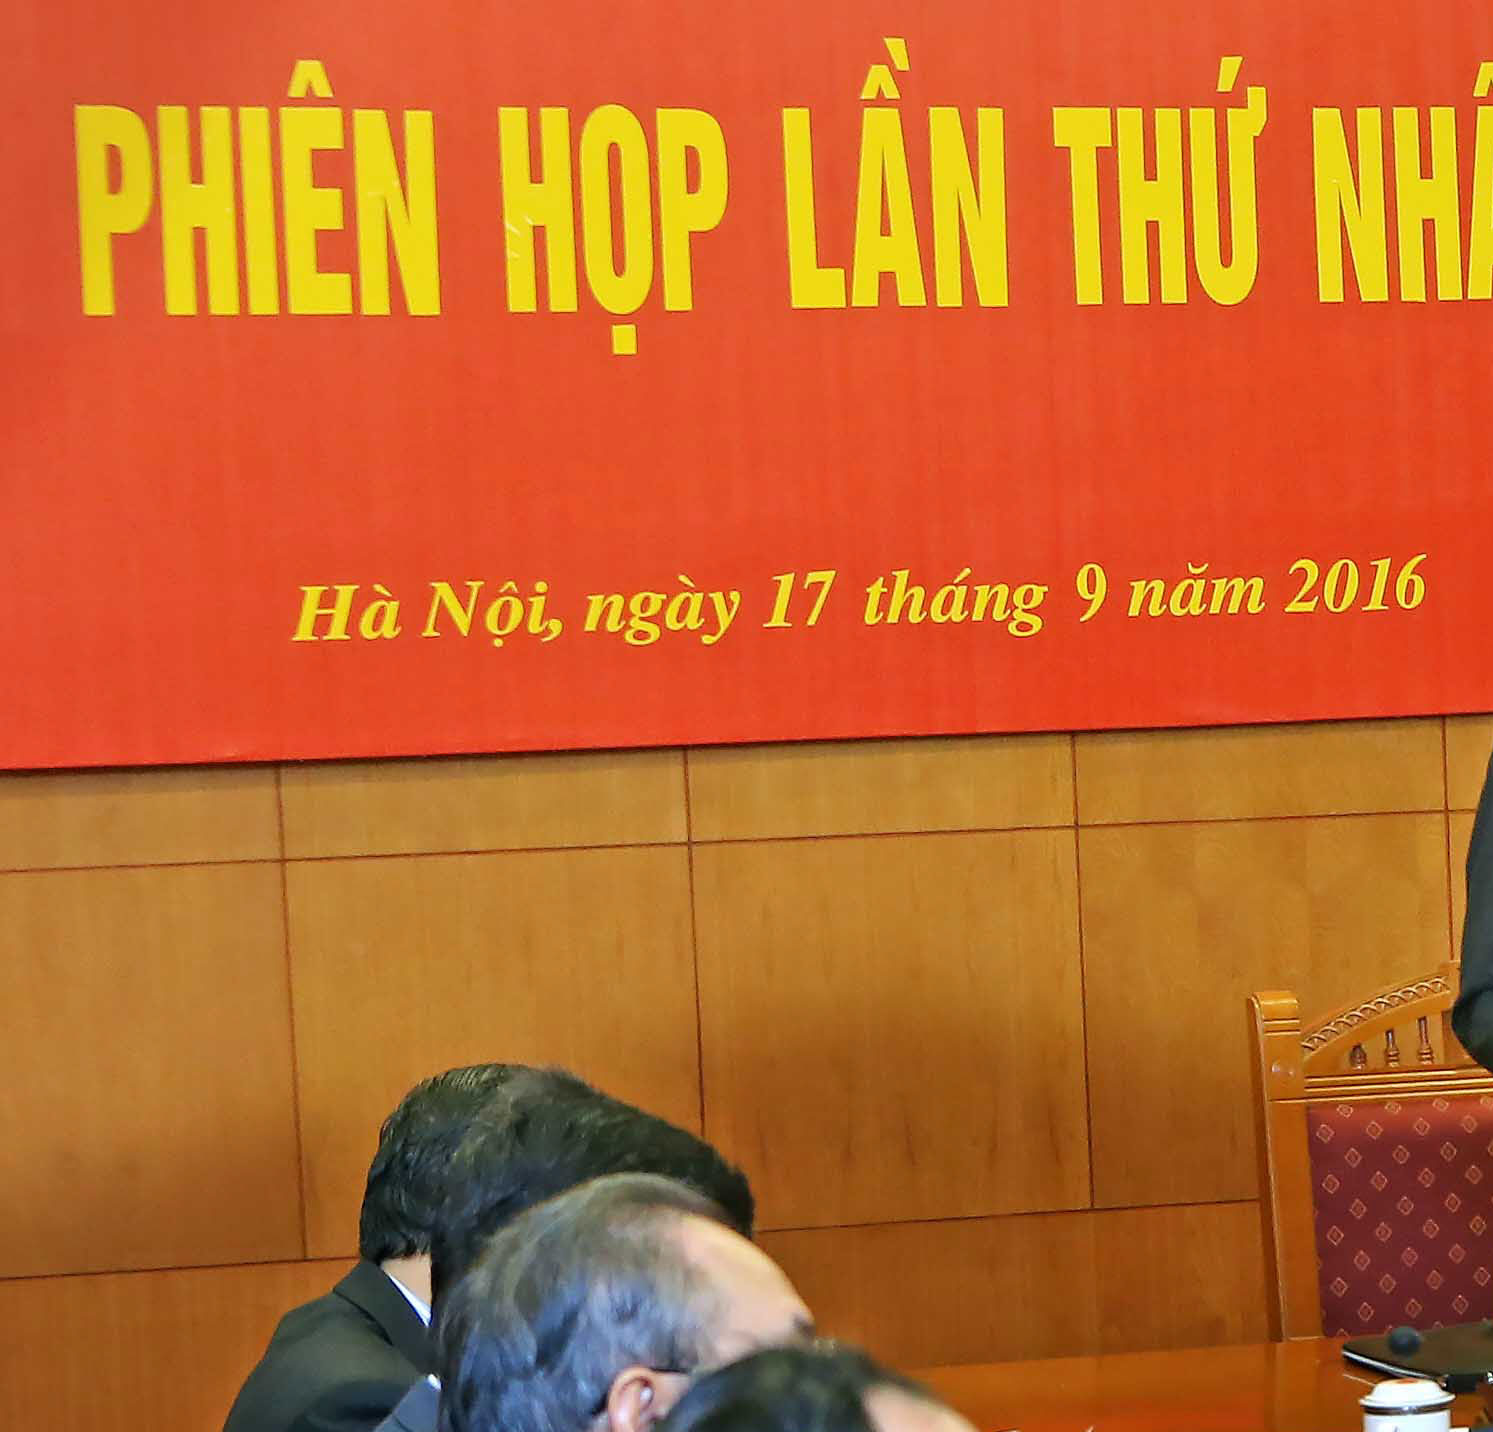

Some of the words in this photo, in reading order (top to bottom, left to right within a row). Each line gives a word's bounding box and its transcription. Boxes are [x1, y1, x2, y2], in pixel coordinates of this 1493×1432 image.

[75, 60, 441, 317] PHIÊN
[498, 103, 729, 355] HỌP
[781, 37, 1009, 309] LẦN
[1053, 55, 1268, 306] THỨ
[292, 583, 402, 641] Hà
[421, 580, 563, 648] Nội,
[583, 575, 741, 646] ngày
[762, 570, 837, 628] 17
[863, 567, 1049, 637] tháng
[1076, 563, 1107, 622] 9
[1127, 562, 1266, 617] năm
[1284, 553, 1427, 613] 2016
